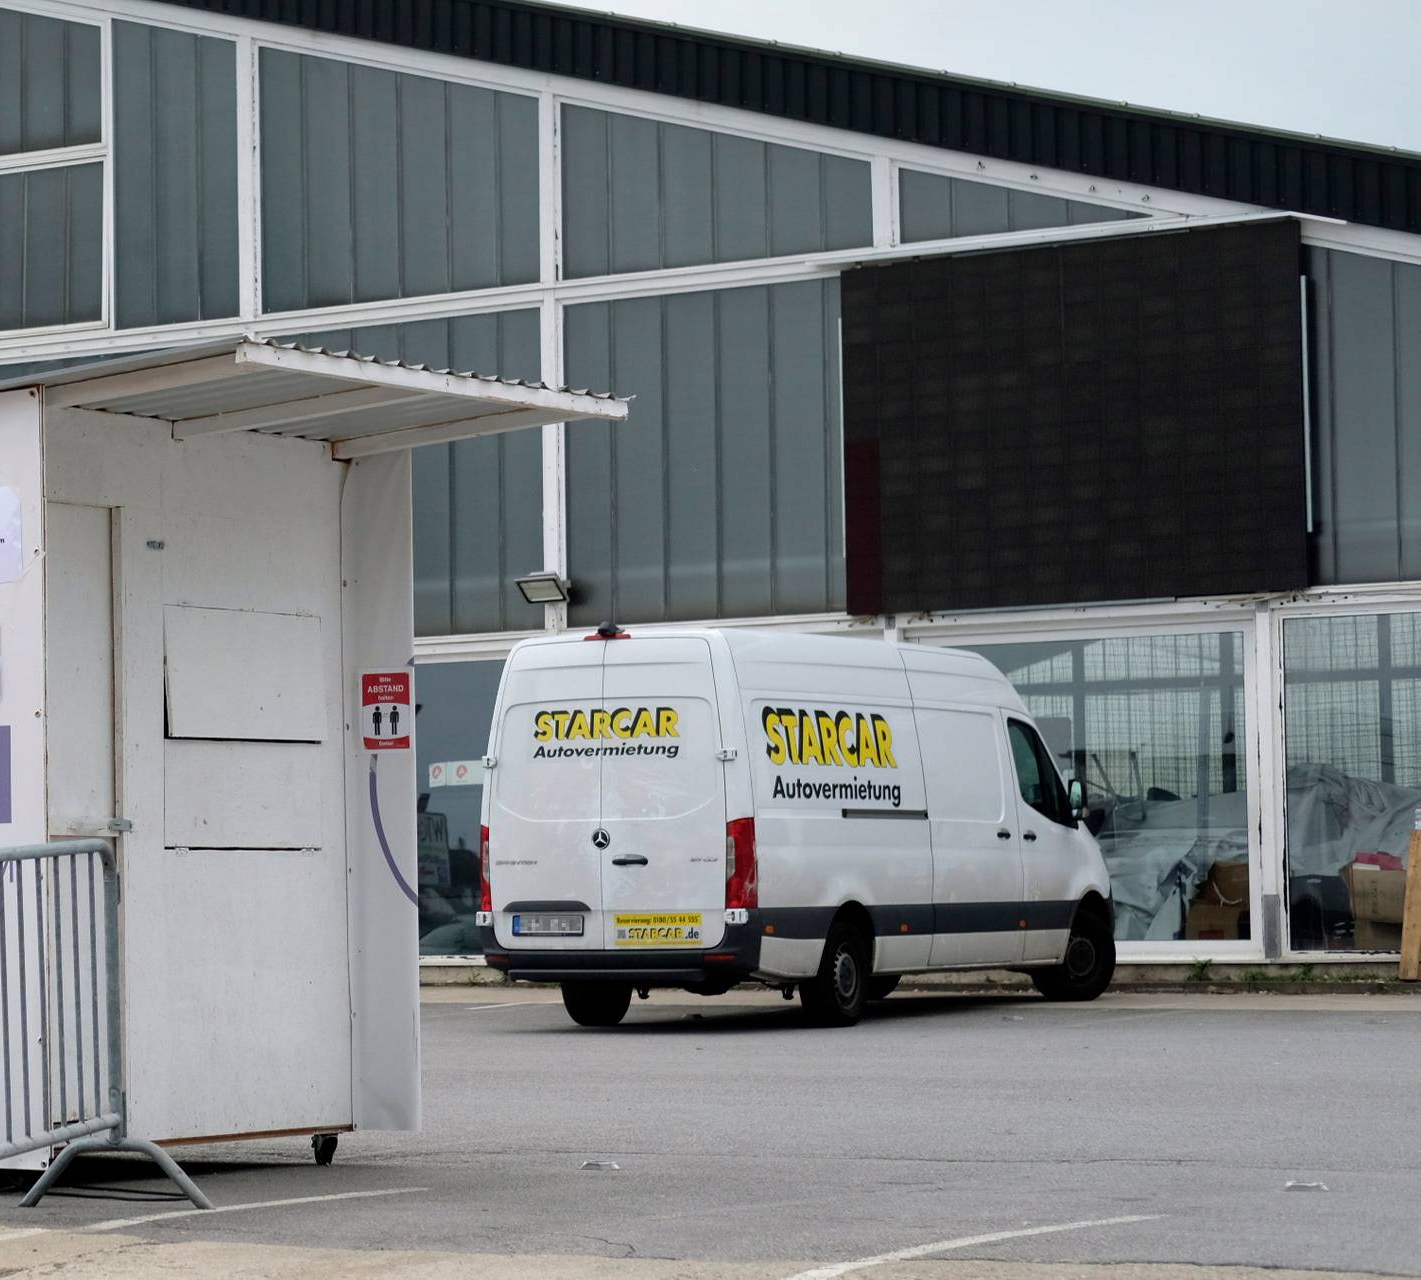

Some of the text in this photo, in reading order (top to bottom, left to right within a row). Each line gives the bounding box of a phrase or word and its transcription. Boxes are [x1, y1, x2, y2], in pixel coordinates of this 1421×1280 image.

[367, 685, 404, 694] ABSTAND
[533, 706, 680, 743] STARCAR
[761, 705, 898, 769] STARCAR
[533, 743, 680, 759] Autovermietung
[772, 775, 901, 807] Autovermietung
